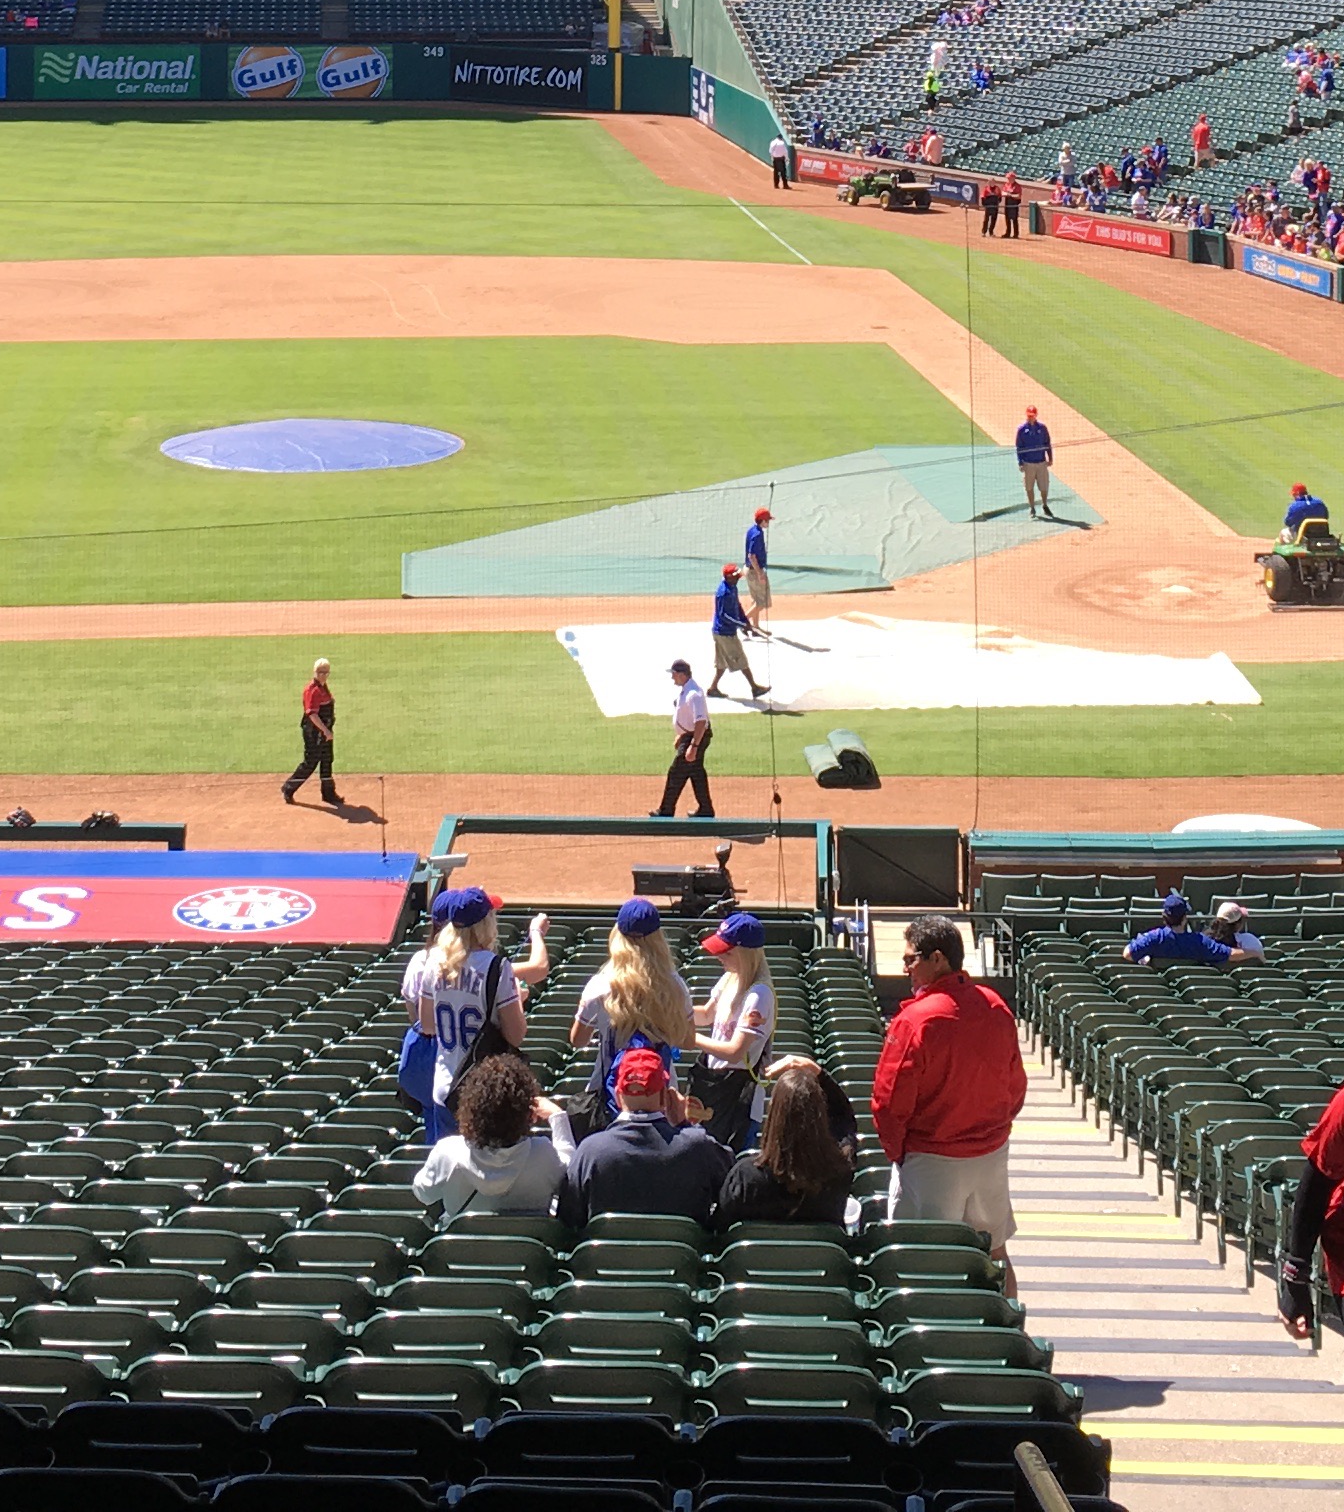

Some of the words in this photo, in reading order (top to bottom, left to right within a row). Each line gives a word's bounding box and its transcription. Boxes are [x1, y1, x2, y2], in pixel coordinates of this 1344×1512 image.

[423, 47, 444, 58] 349
[590, 54, 607, 66] 325
[237, 58, 298, 88] Gulf
[321, 58, 382, 88] Gulf
[116, 82, 141, 93] Car
[144, 81, 189, 94] Rental
[1095, 224, 1111, 239] THIS
[436, 1000, 485, 1053] 06
